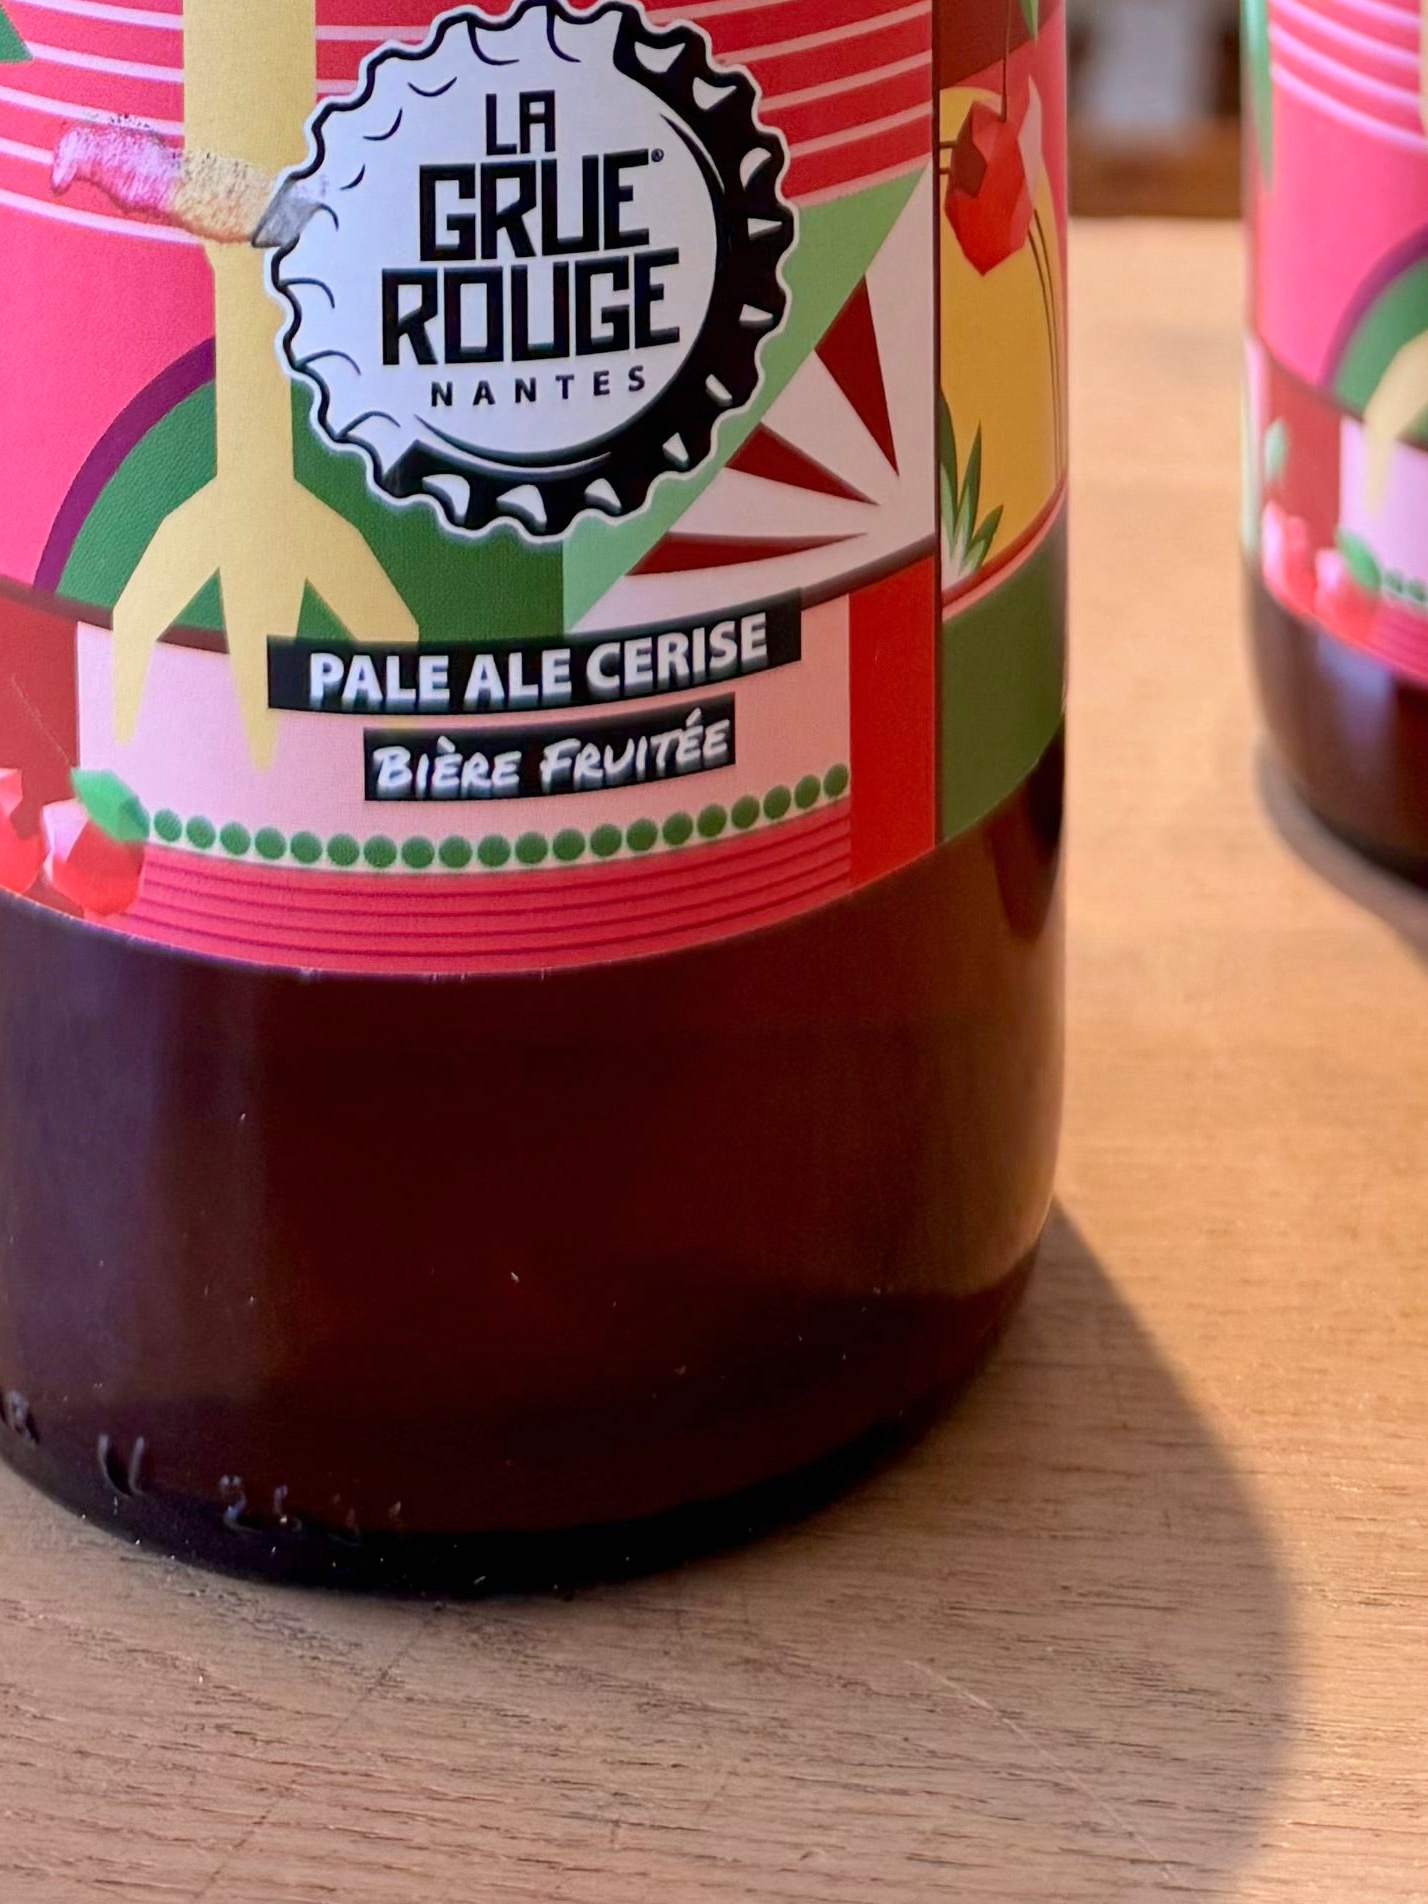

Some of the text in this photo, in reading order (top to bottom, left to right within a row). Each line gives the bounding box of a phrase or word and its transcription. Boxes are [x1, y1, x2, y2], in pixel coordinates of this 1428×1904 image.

[485, 90, 556, 156] LA
[382, 248, 681, 365] ROUGE
[431, 366, 645, 406] NANTES
[309, 611, 769, 704] PALE ALE CERISE
[371, 707, 731, 791] BIÈRE FRUITÉE
